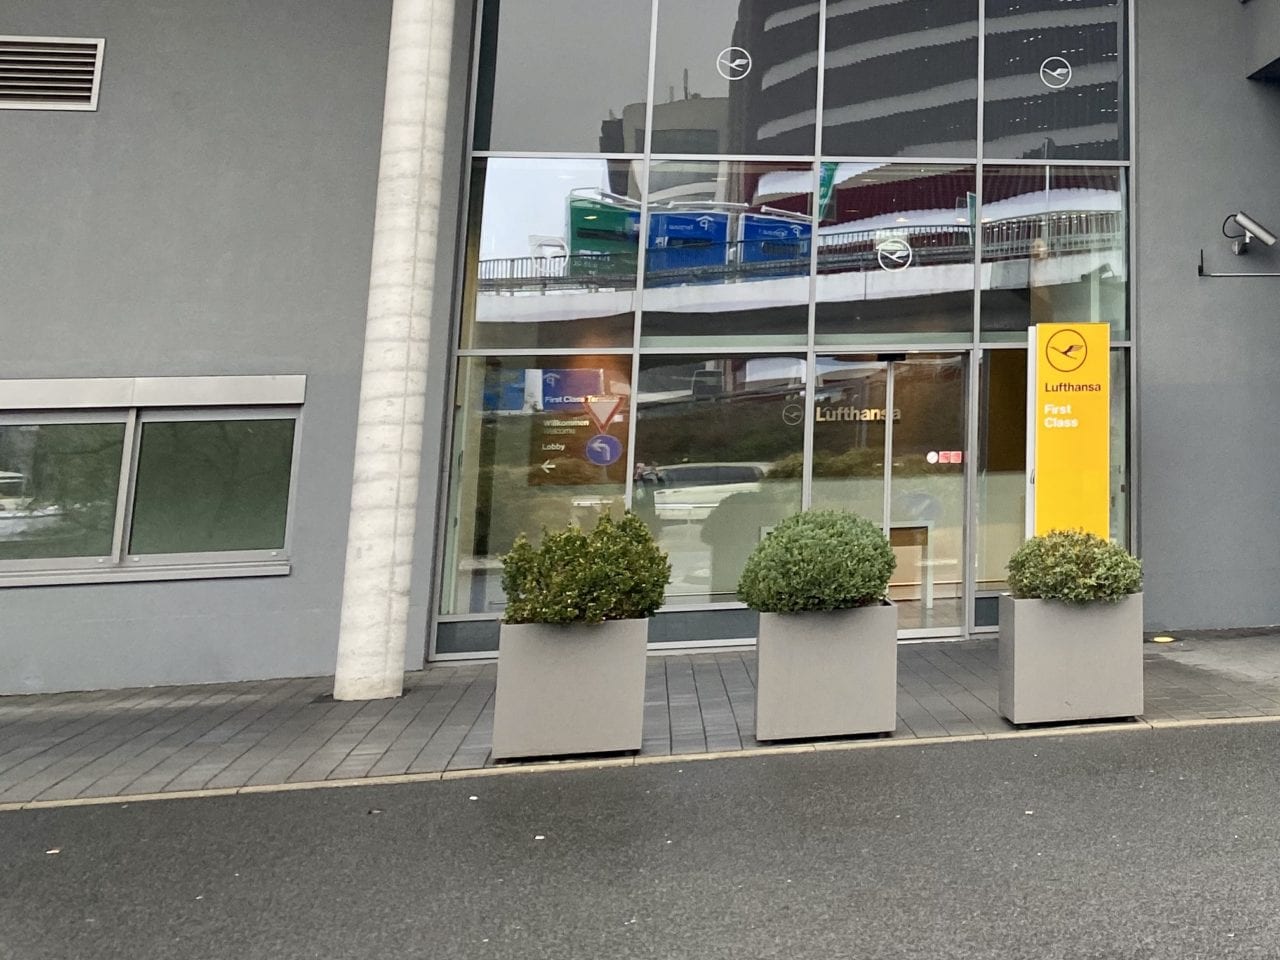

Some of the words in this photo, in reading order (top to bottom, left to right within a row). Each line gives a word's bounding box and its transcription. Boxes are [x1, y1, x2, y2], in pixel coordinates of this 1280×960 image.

[1045, 382, 1101, 392] Lufthansa
[1044, 404, 1072, 415] First
[1044, 417, 1079, 428] Class
[542, 443, 565, 451] Lobby
